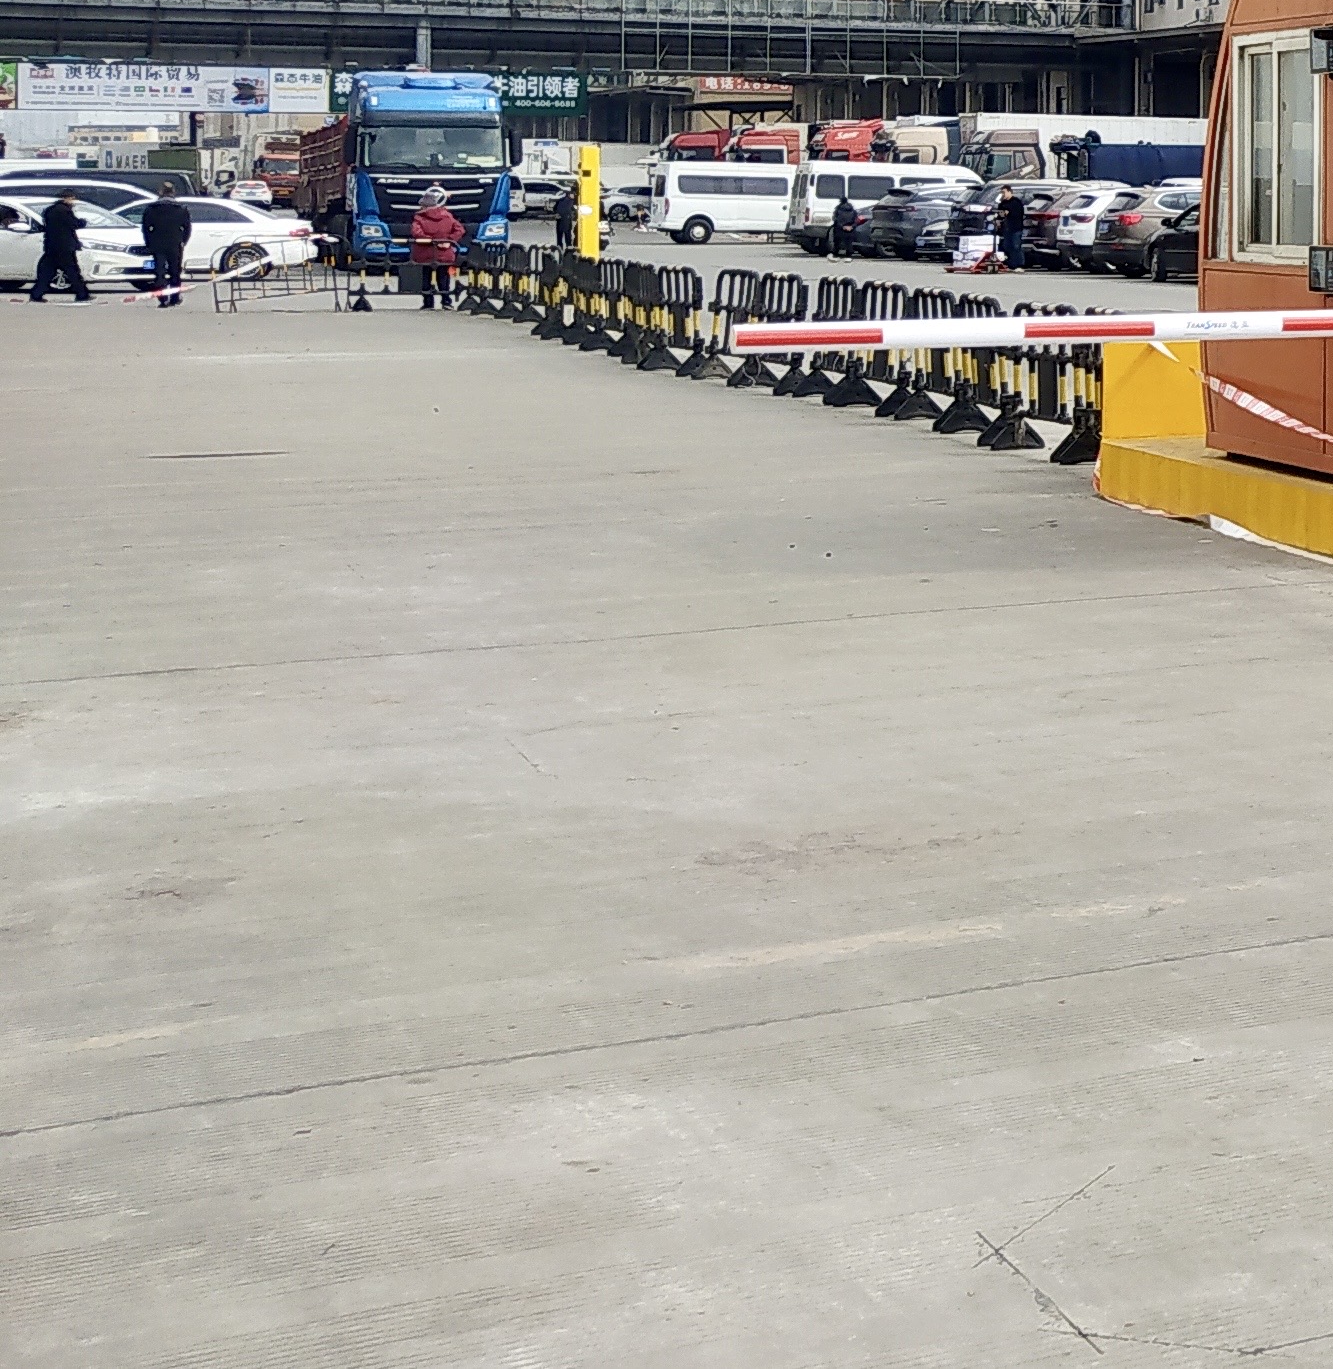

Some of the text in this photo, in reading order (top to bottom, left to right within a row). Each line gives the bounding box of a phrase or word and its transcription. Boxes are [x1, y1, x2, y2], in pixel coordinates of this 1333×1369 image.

[64, 64, 201, 82] 澳牧特国际贸易
